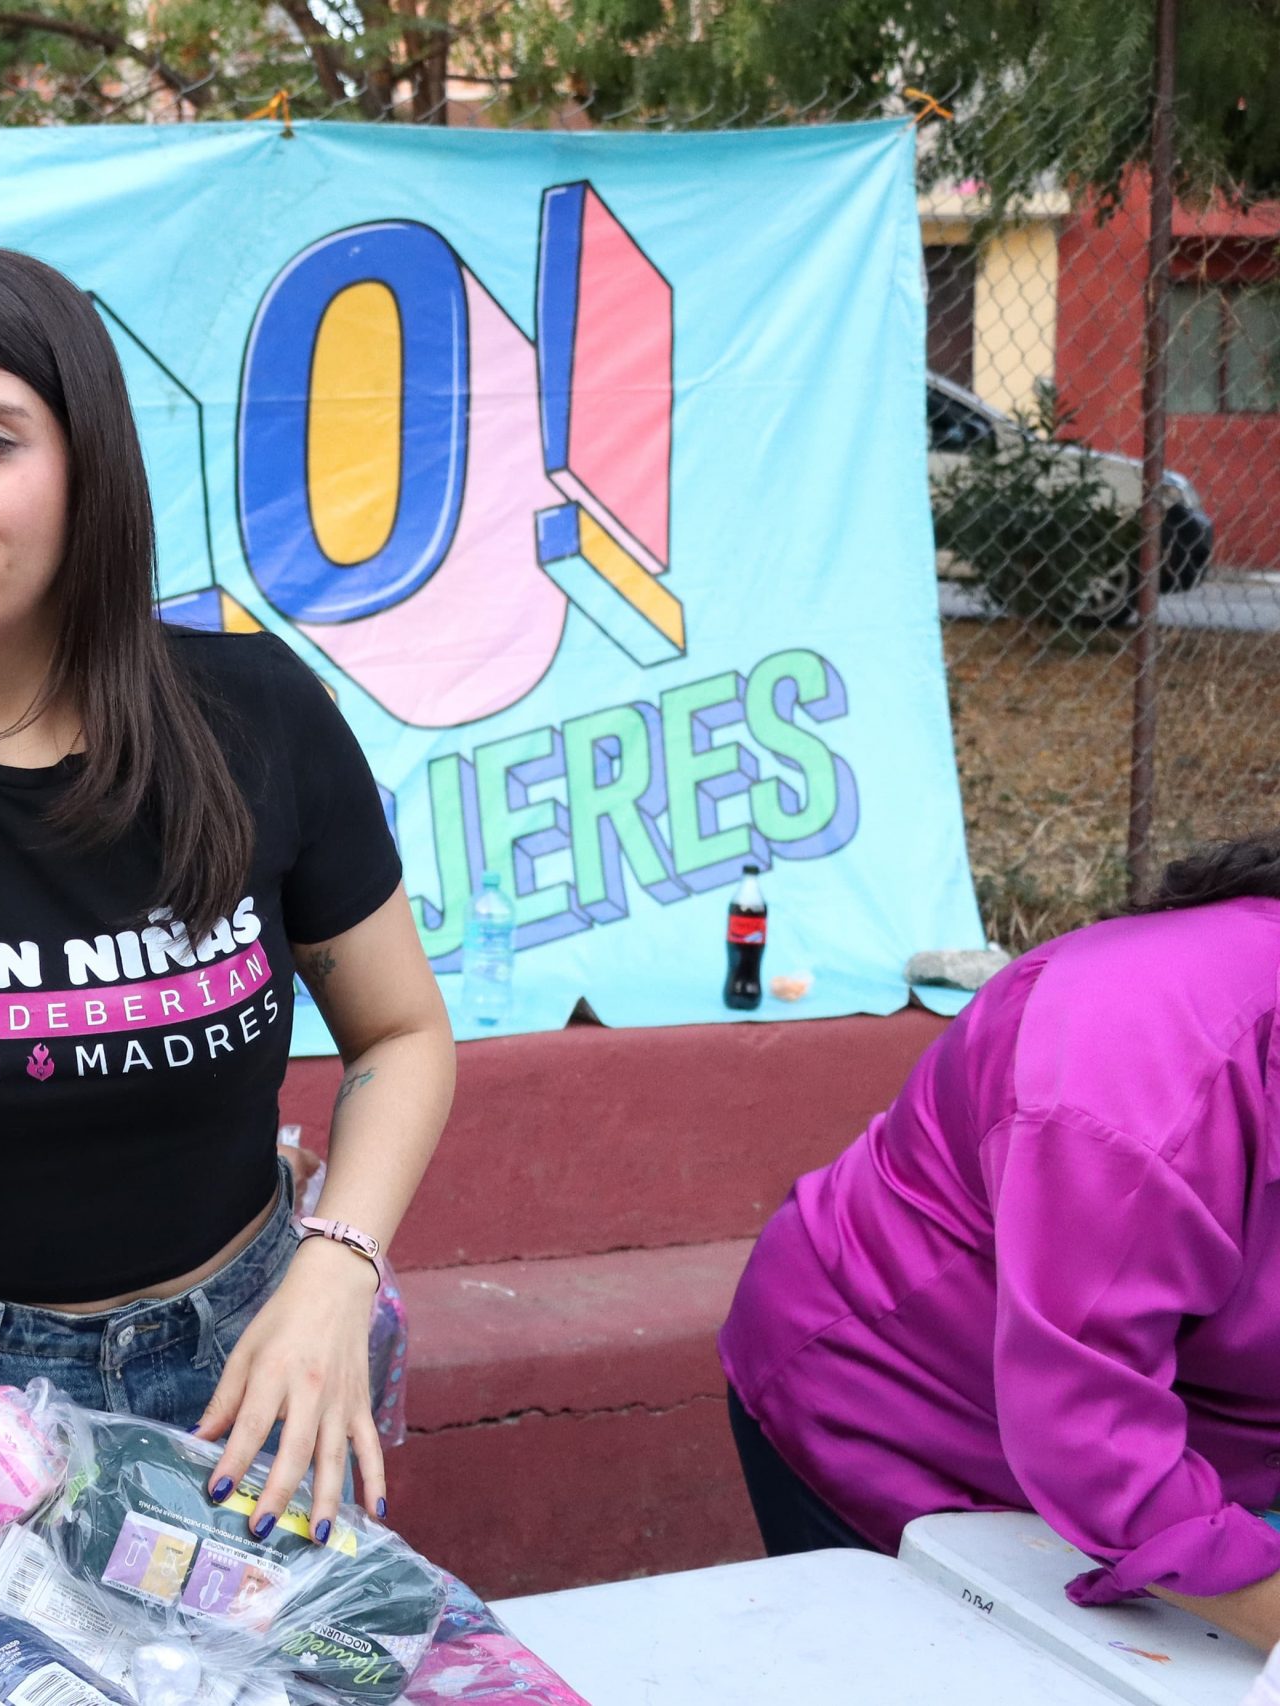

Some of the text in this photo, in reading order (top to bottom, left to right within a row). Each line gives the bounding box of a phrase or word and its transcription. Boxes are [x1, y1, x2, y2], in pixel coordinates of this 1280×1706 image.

[409, 648, 858, 970] JERES
[9, 953, 265, 1031] DEBERÍAN
[75, 989, 279, 1076] MADRES
[314, 1624, 369, 1652] NOCTURNA
